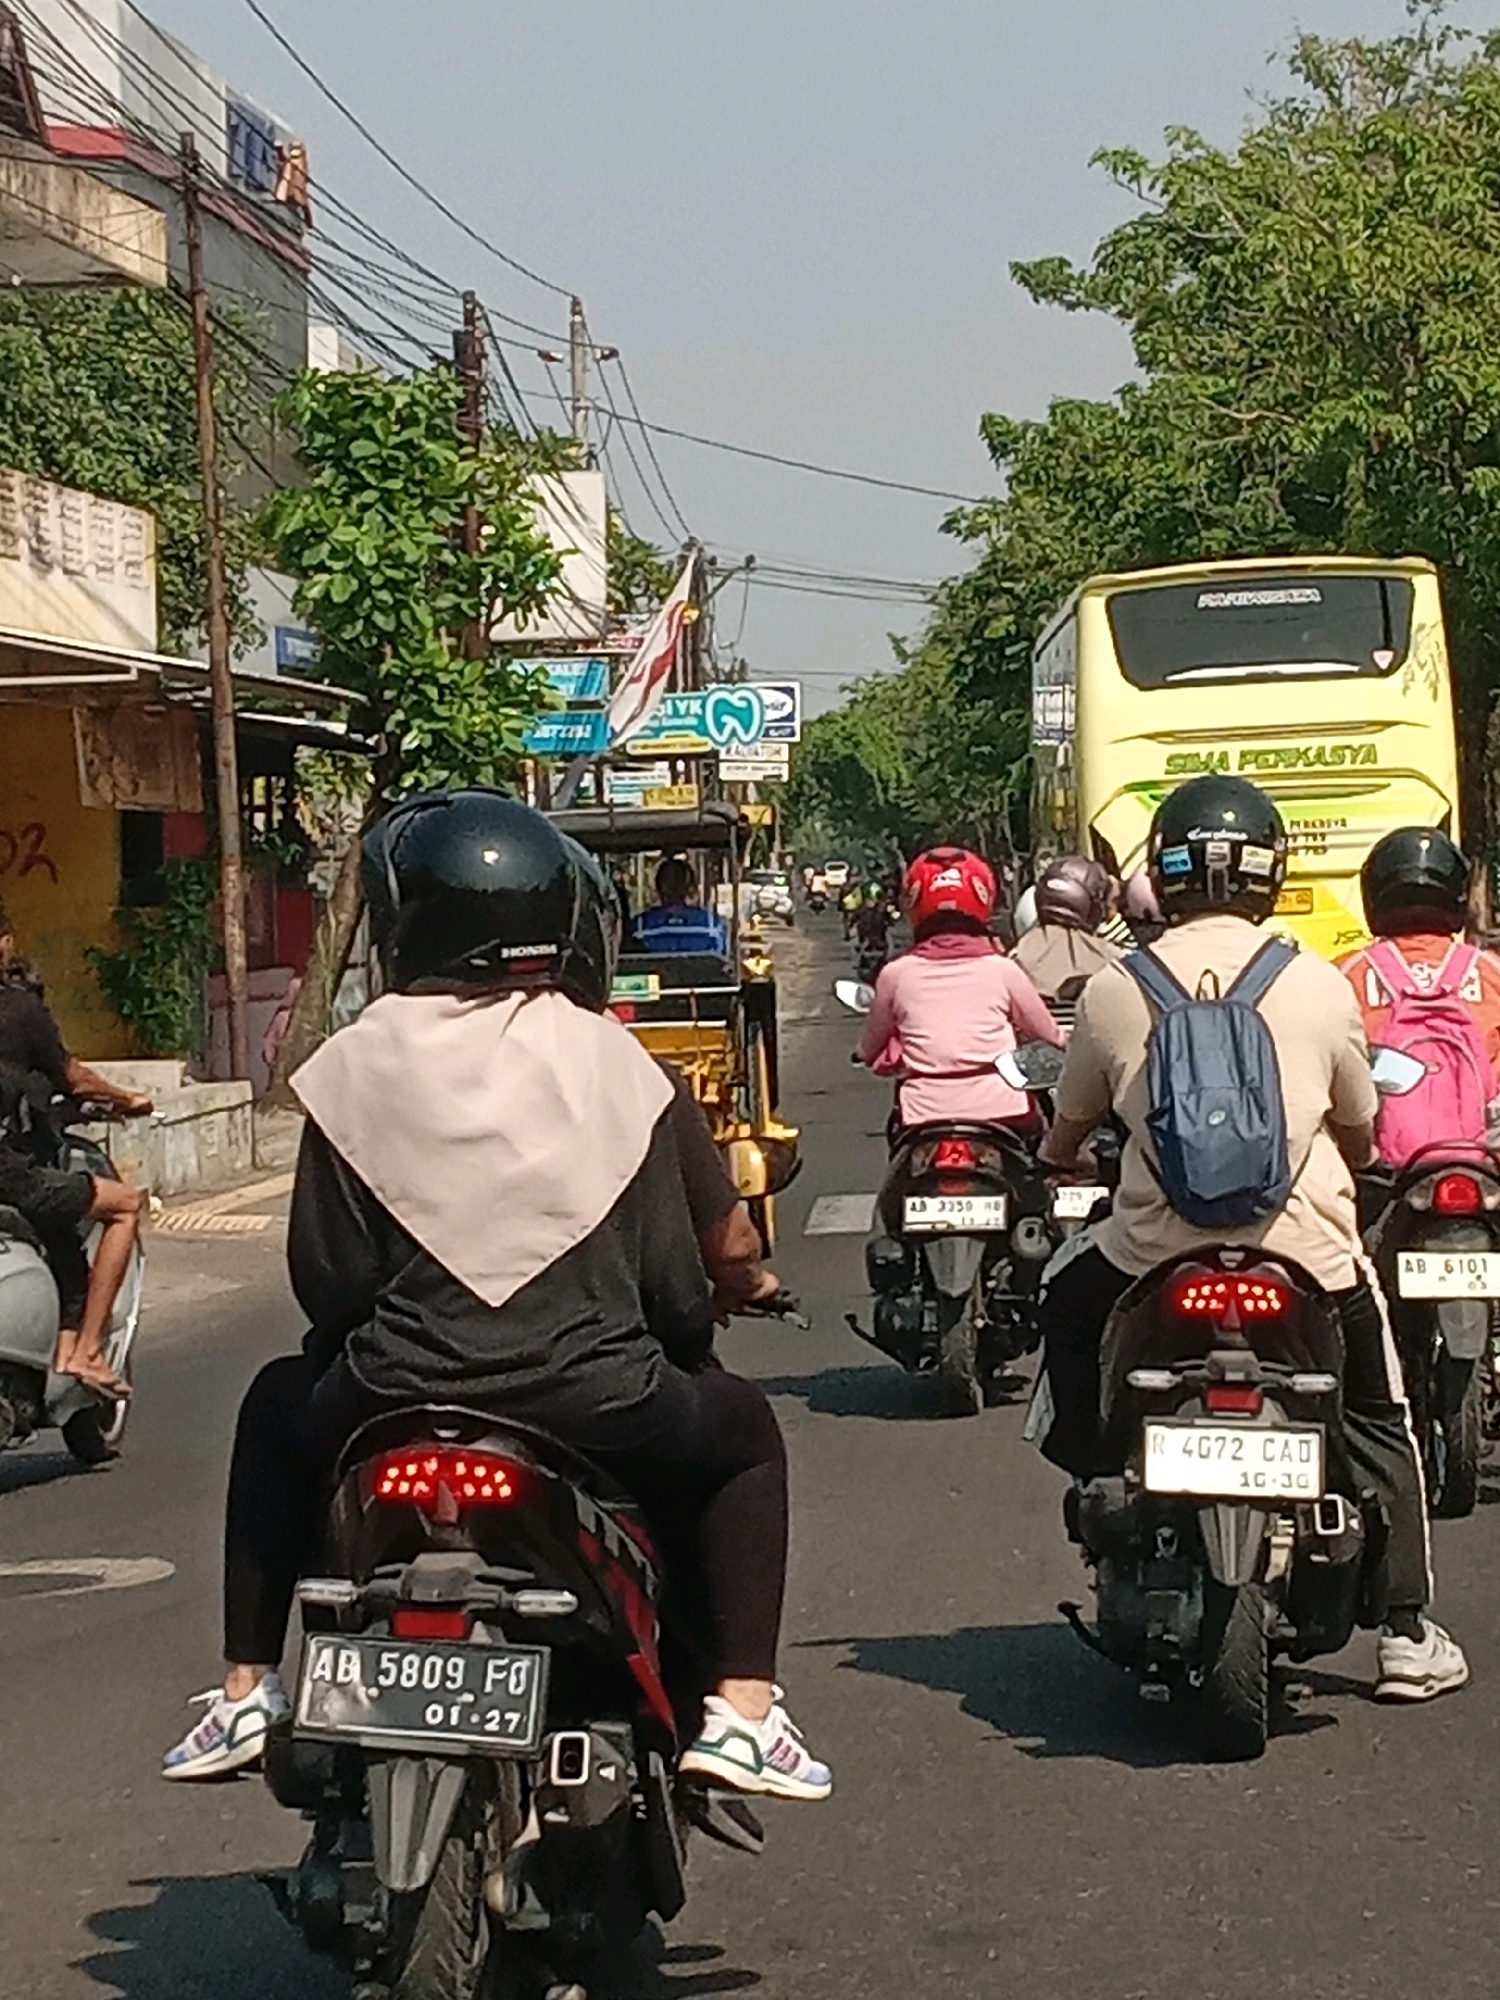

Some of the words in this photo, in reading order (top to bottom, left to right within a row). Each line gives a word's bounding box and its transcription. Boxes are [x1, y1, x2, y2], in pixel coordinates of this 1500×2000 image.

[500, 944, 558, 959] HONDA
[1404, 1258, 1427, 1275] AB
[1443, 1257, 1488, 1275] 6101
[1152, 1432, 1166, 1456] R
[1181, 1435, 1244, 1462] 4072
[312, 1647, 361, 1684] AB
[377, 1651, 466, 1690] 5809
